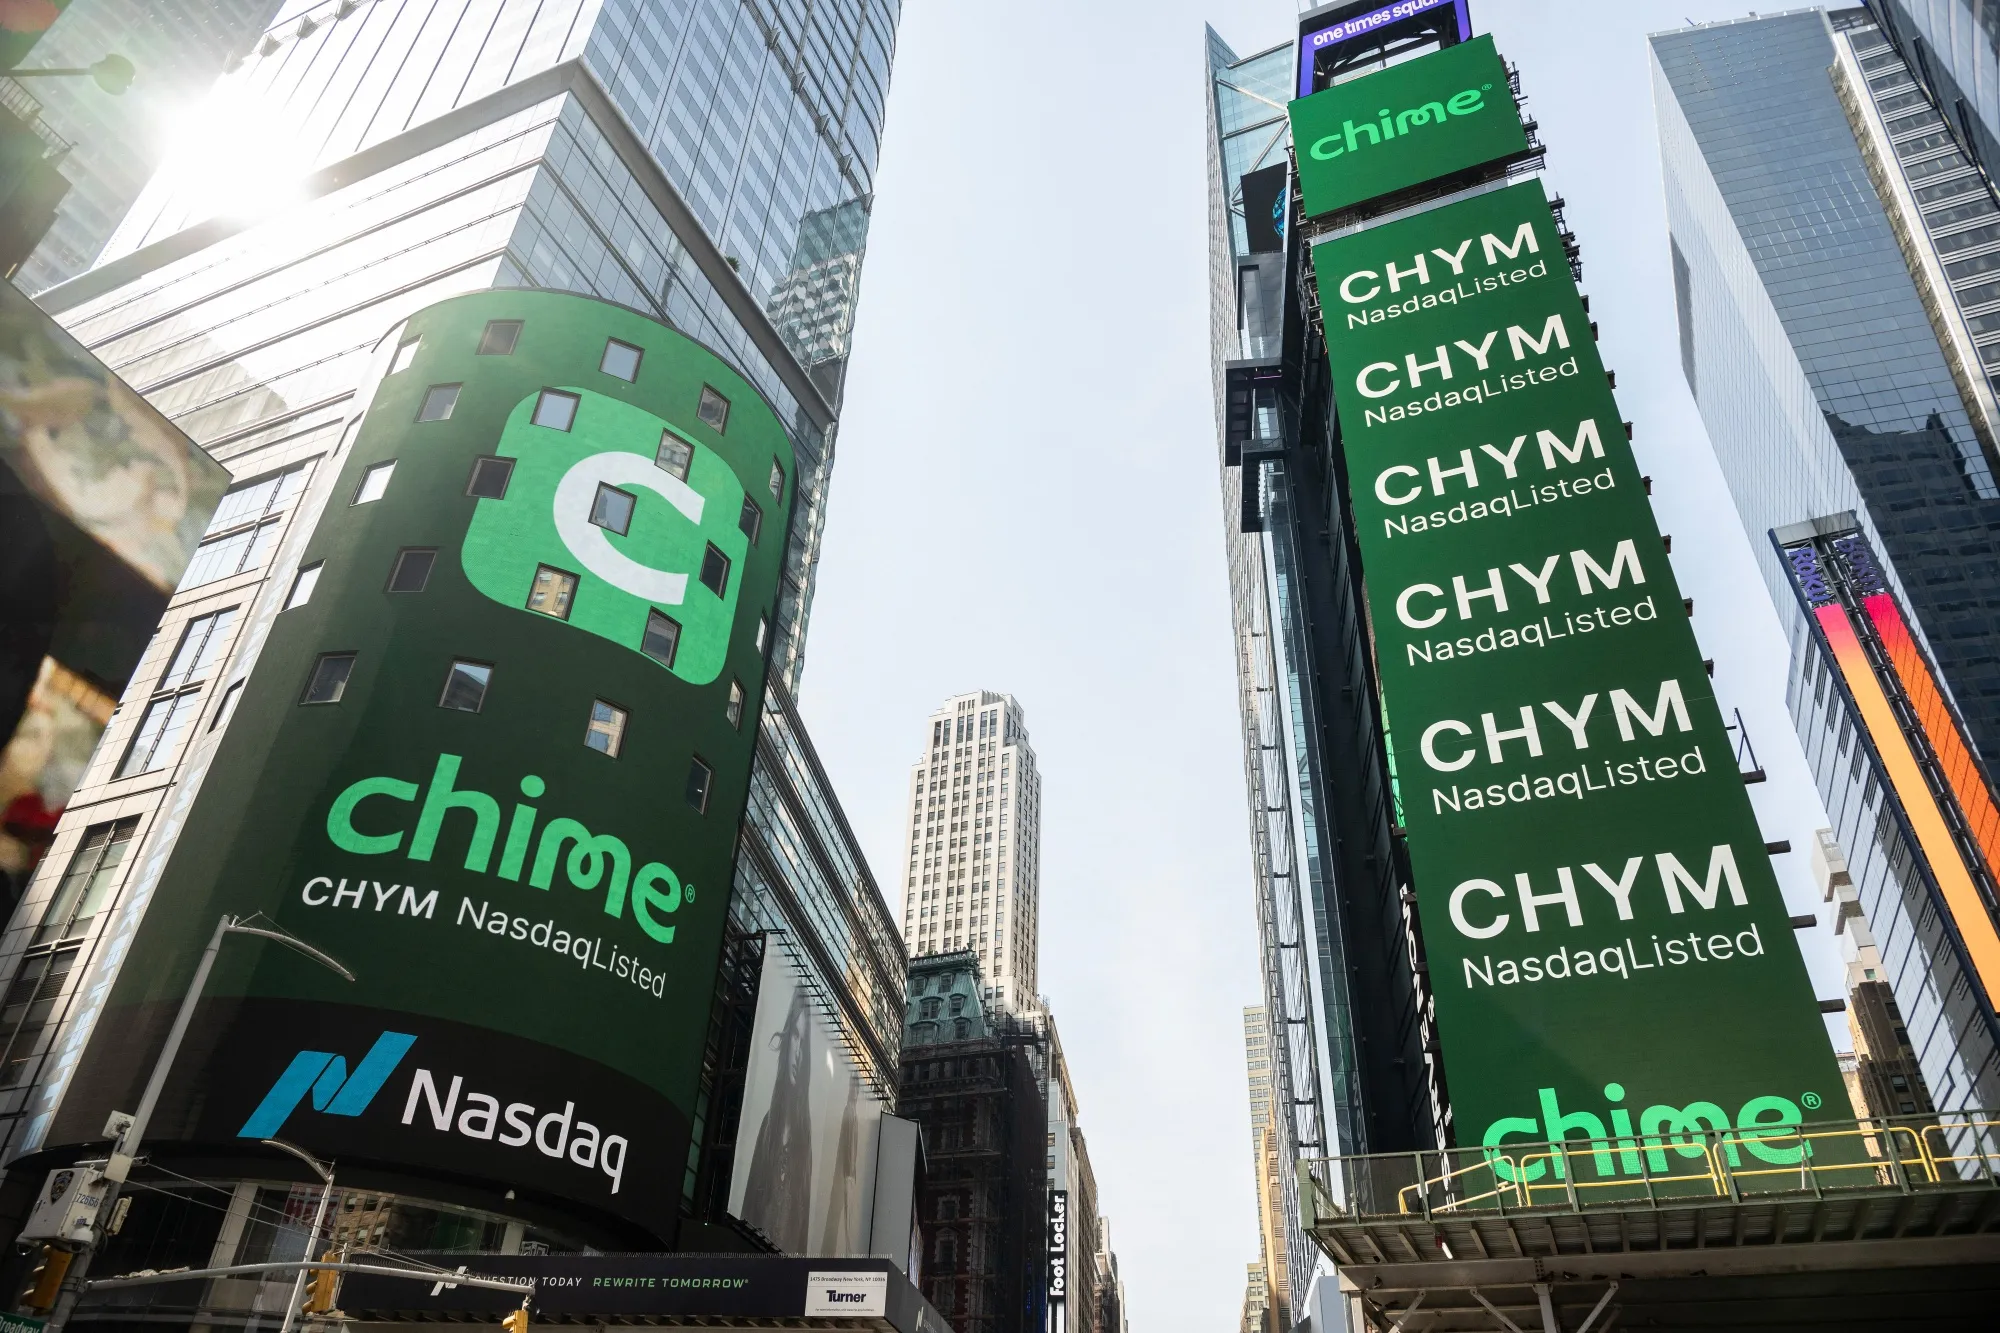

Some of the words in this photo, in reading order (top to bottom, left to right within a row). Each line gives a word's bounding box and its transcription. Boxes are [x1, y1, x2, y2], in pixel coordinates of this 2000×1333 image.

[1313, 27, 1344, 46] one
[1340, 221, 1541, 304] CHYM
[1347, 259, 1548, 330] NasdaqListed
[1356, 313, 1571, 399] CHYM
[1364, 356, 1579, 429] NasdaqListed
[1374, 418, 1606, 506] CHYM
[1383, 467, 1617, 539] NasdaqListed
[1394, 538, 1646, 629] CHYM
[1406, 595, 1659, 668] NasdaqListed
[1419, 678, 1695, 773] CHYM
[1432, 745, 1708, 815] NasdaqListed
[1448, 843, 1749, 940] CHYM
[301, 876, 440, 920] CHYM
[456, 896, 666, 999] NasdaqListed
[1462, 922, 1766, 989] NasdaqListed
[401, 1068, 628, 1195] Nasdaq
[542, 1276, 583, 1287] TODAY
[593, 1277, 656, 1288] REWRITE
[826, 1289, 867, 1303] Turner
[1050, 1257, 1065, 1297] Foot
